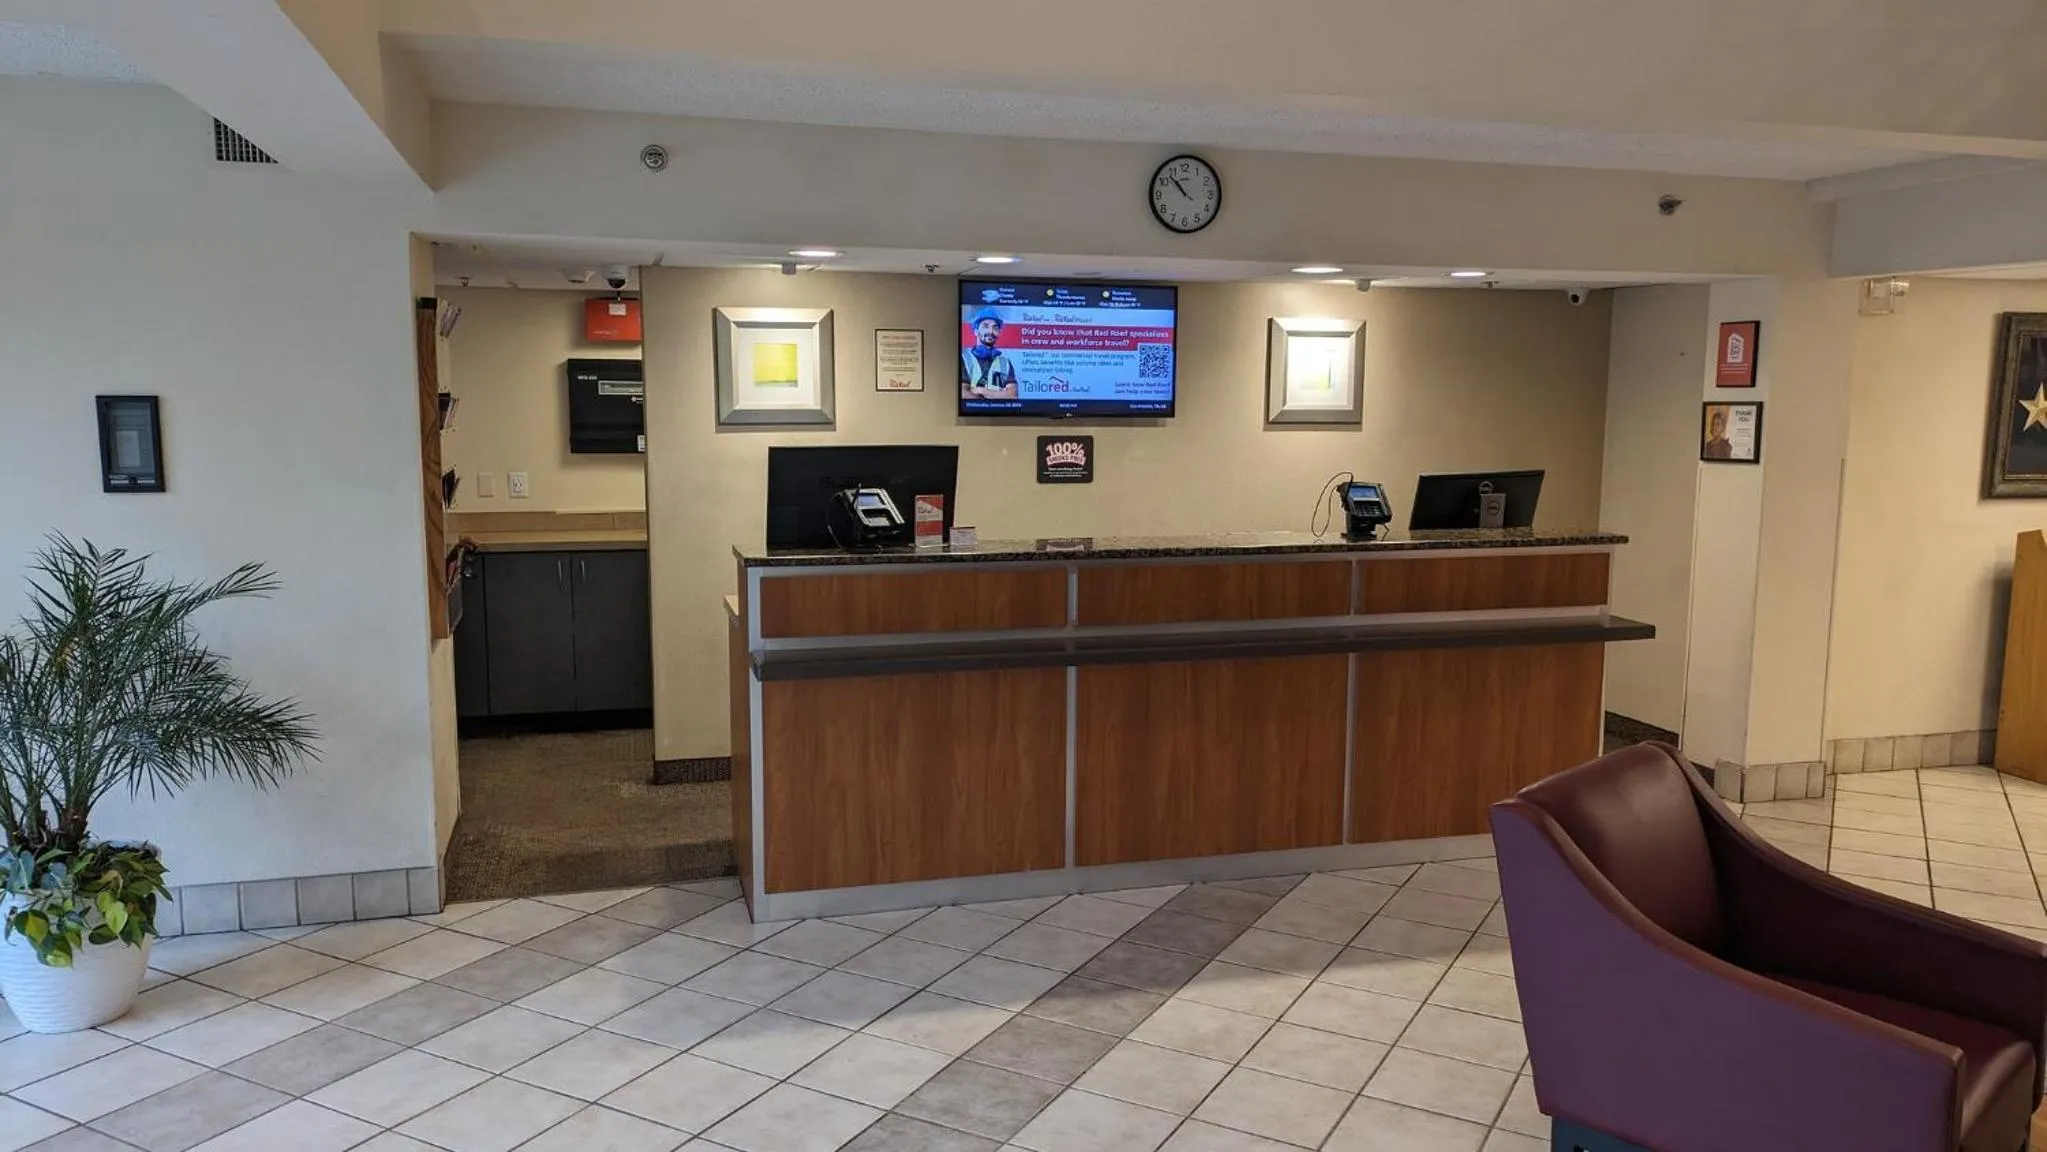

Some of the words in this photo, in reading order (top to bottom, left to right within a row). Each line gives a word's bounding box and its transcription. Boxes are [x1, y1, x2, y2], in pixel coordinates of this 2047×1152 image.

[1203, 176, 1210, 186] 2
[1155, 190, 1162, 200] 9
[1160, 204, 1167, 213] 8
[1181, 216, 1188, 227] 6
[1021, 327, 1036, 335] Did
[1037, 329, 1052, 337] you
[1053, 328, 1075, 336] know
[1094, 329, 1109, 337] Red
[1110, 329, 1129, 337] Roof
[1130, 330, 1168, 338] specializes
[1065, 338, 1103, 346] workforce
[1022, 380, 1069, 393] Tailored
[1046, 441, 1085, 457] 100%
